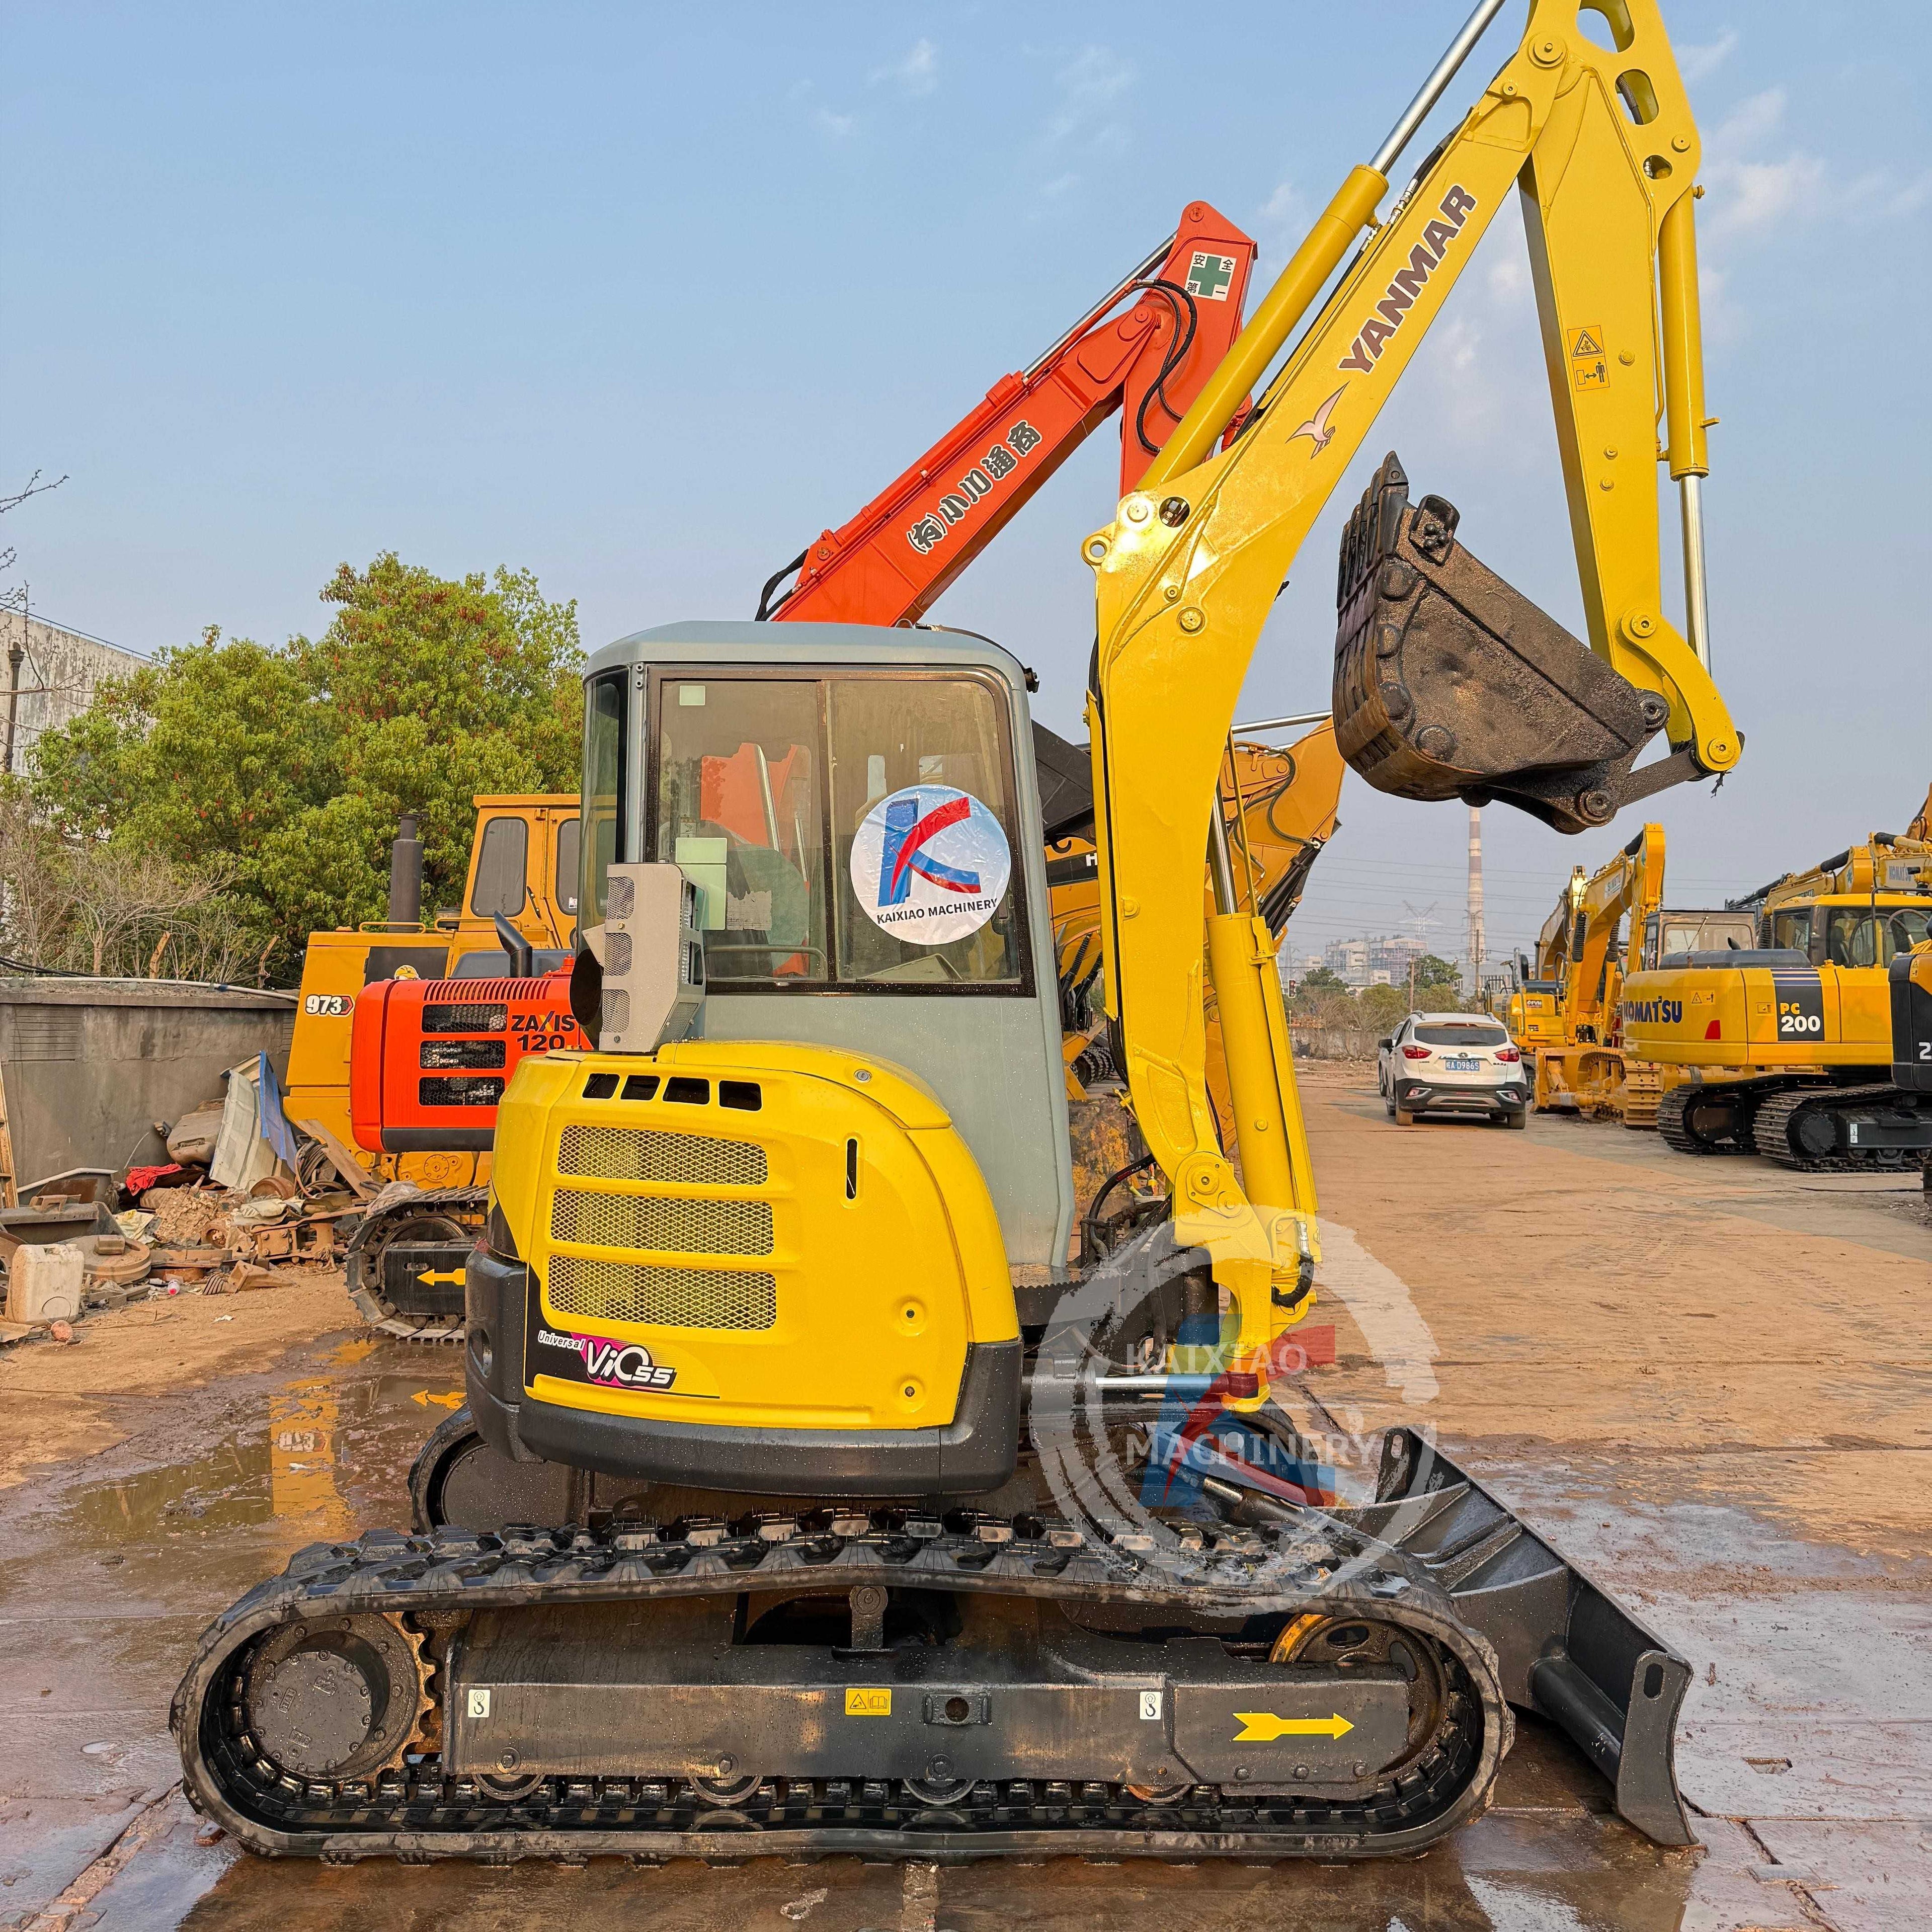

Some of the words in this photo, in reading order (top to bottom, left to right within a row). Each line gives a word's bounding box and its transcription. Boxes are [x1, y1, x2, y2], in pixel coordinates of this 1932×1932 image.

[1339, 184, 1476, 373] YANMAR
[877, 909, 925, 924] KAIXIAO
[928, 898, 998, 917] MACHINERY
[305, 995, 343, 1014] 973
[1780, 1002, 1800, 1015] PC
[511, 1010, 577, 1032] ZAXIS
[1781, 1015, 1821, 1032] 200
[517, 1034, 565, 1052] 120
[538, 1330, 586, 1351] Universal
